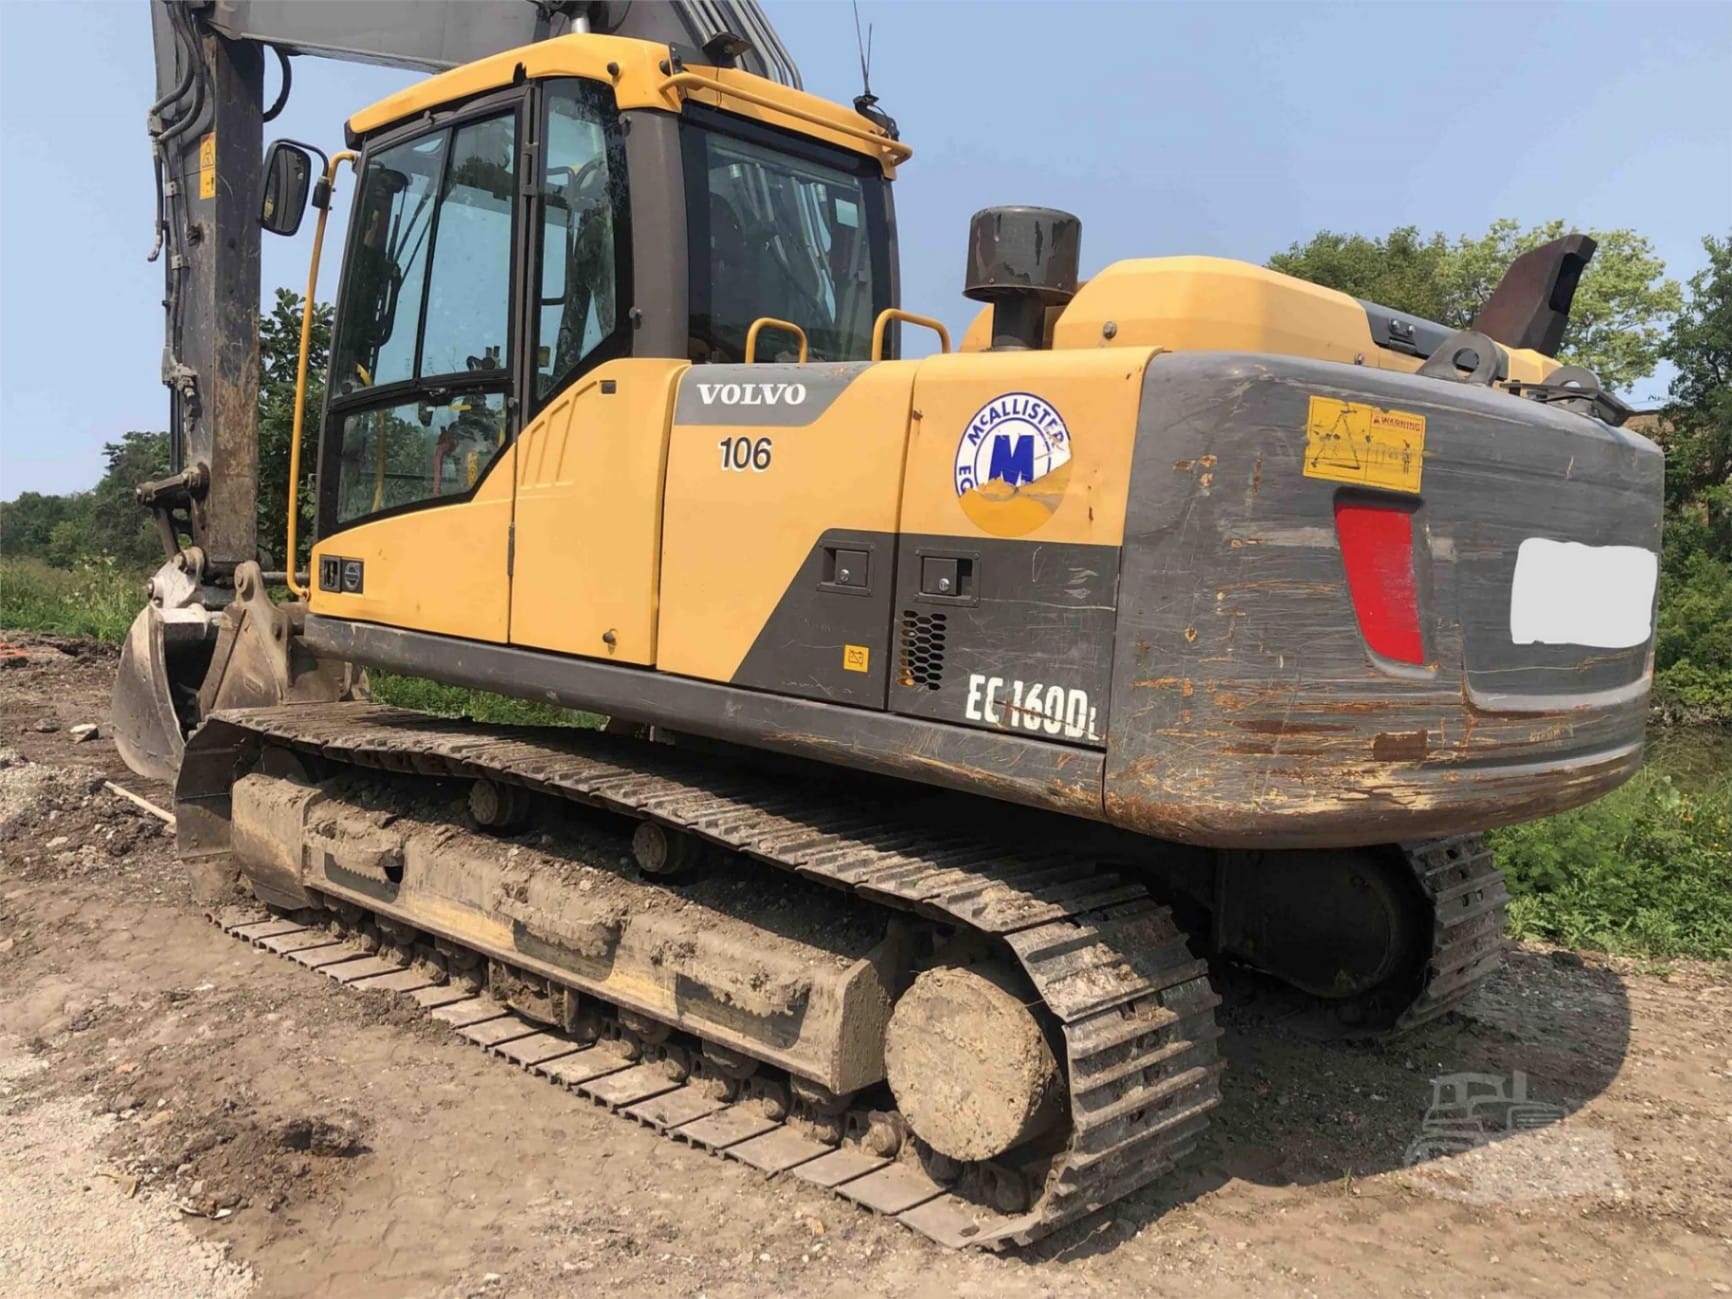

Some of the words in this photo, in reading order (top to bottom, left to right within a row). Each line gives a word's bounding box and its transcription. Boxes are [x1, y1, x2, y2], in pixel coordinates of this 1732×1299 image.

[696, 383, 807, 405] VOLVO
[719, 436, 773, 471] 106
[988, 434, 1035, 486] M
[965, 673, 1004, 723] EC
